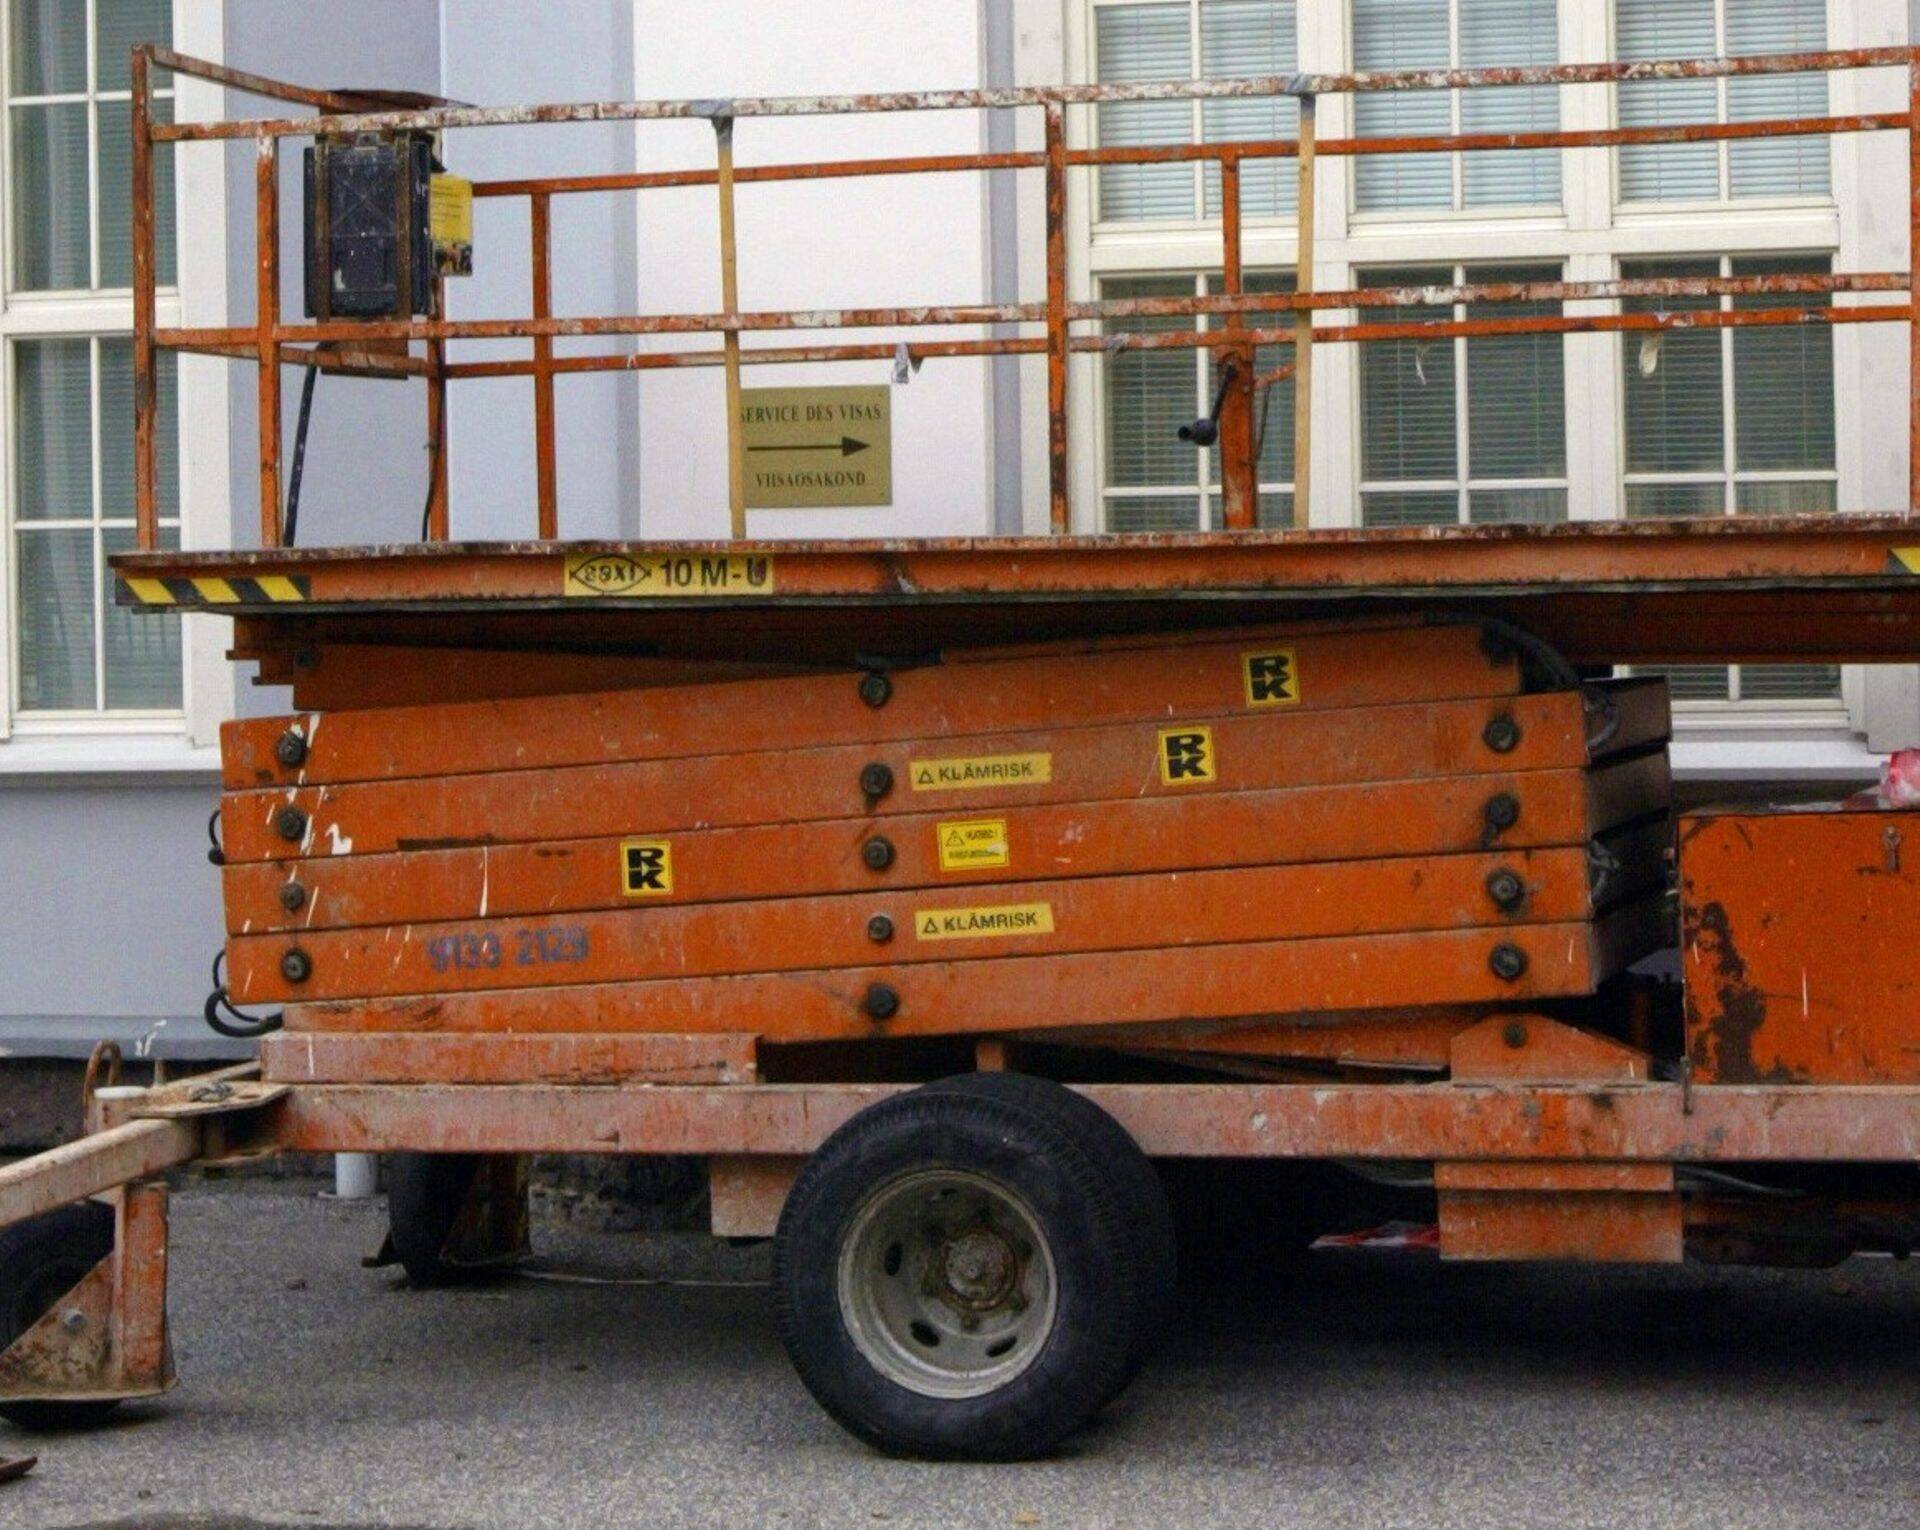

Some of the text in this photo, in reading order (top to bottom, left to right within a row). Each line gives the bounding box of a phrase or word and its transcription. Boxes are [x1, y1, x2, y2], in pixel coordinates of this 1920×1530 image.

[806, 405, 833, 422] DES
[839, 403, 882, 421] VISAS
[756, 471, 866, 489] VIISAOSAKOND
[660, 558, 693, 587] 10
[939, 761, 1033, 783] KLÄMRISK
[944, 911, 1038, 931] KLÄMRISK
